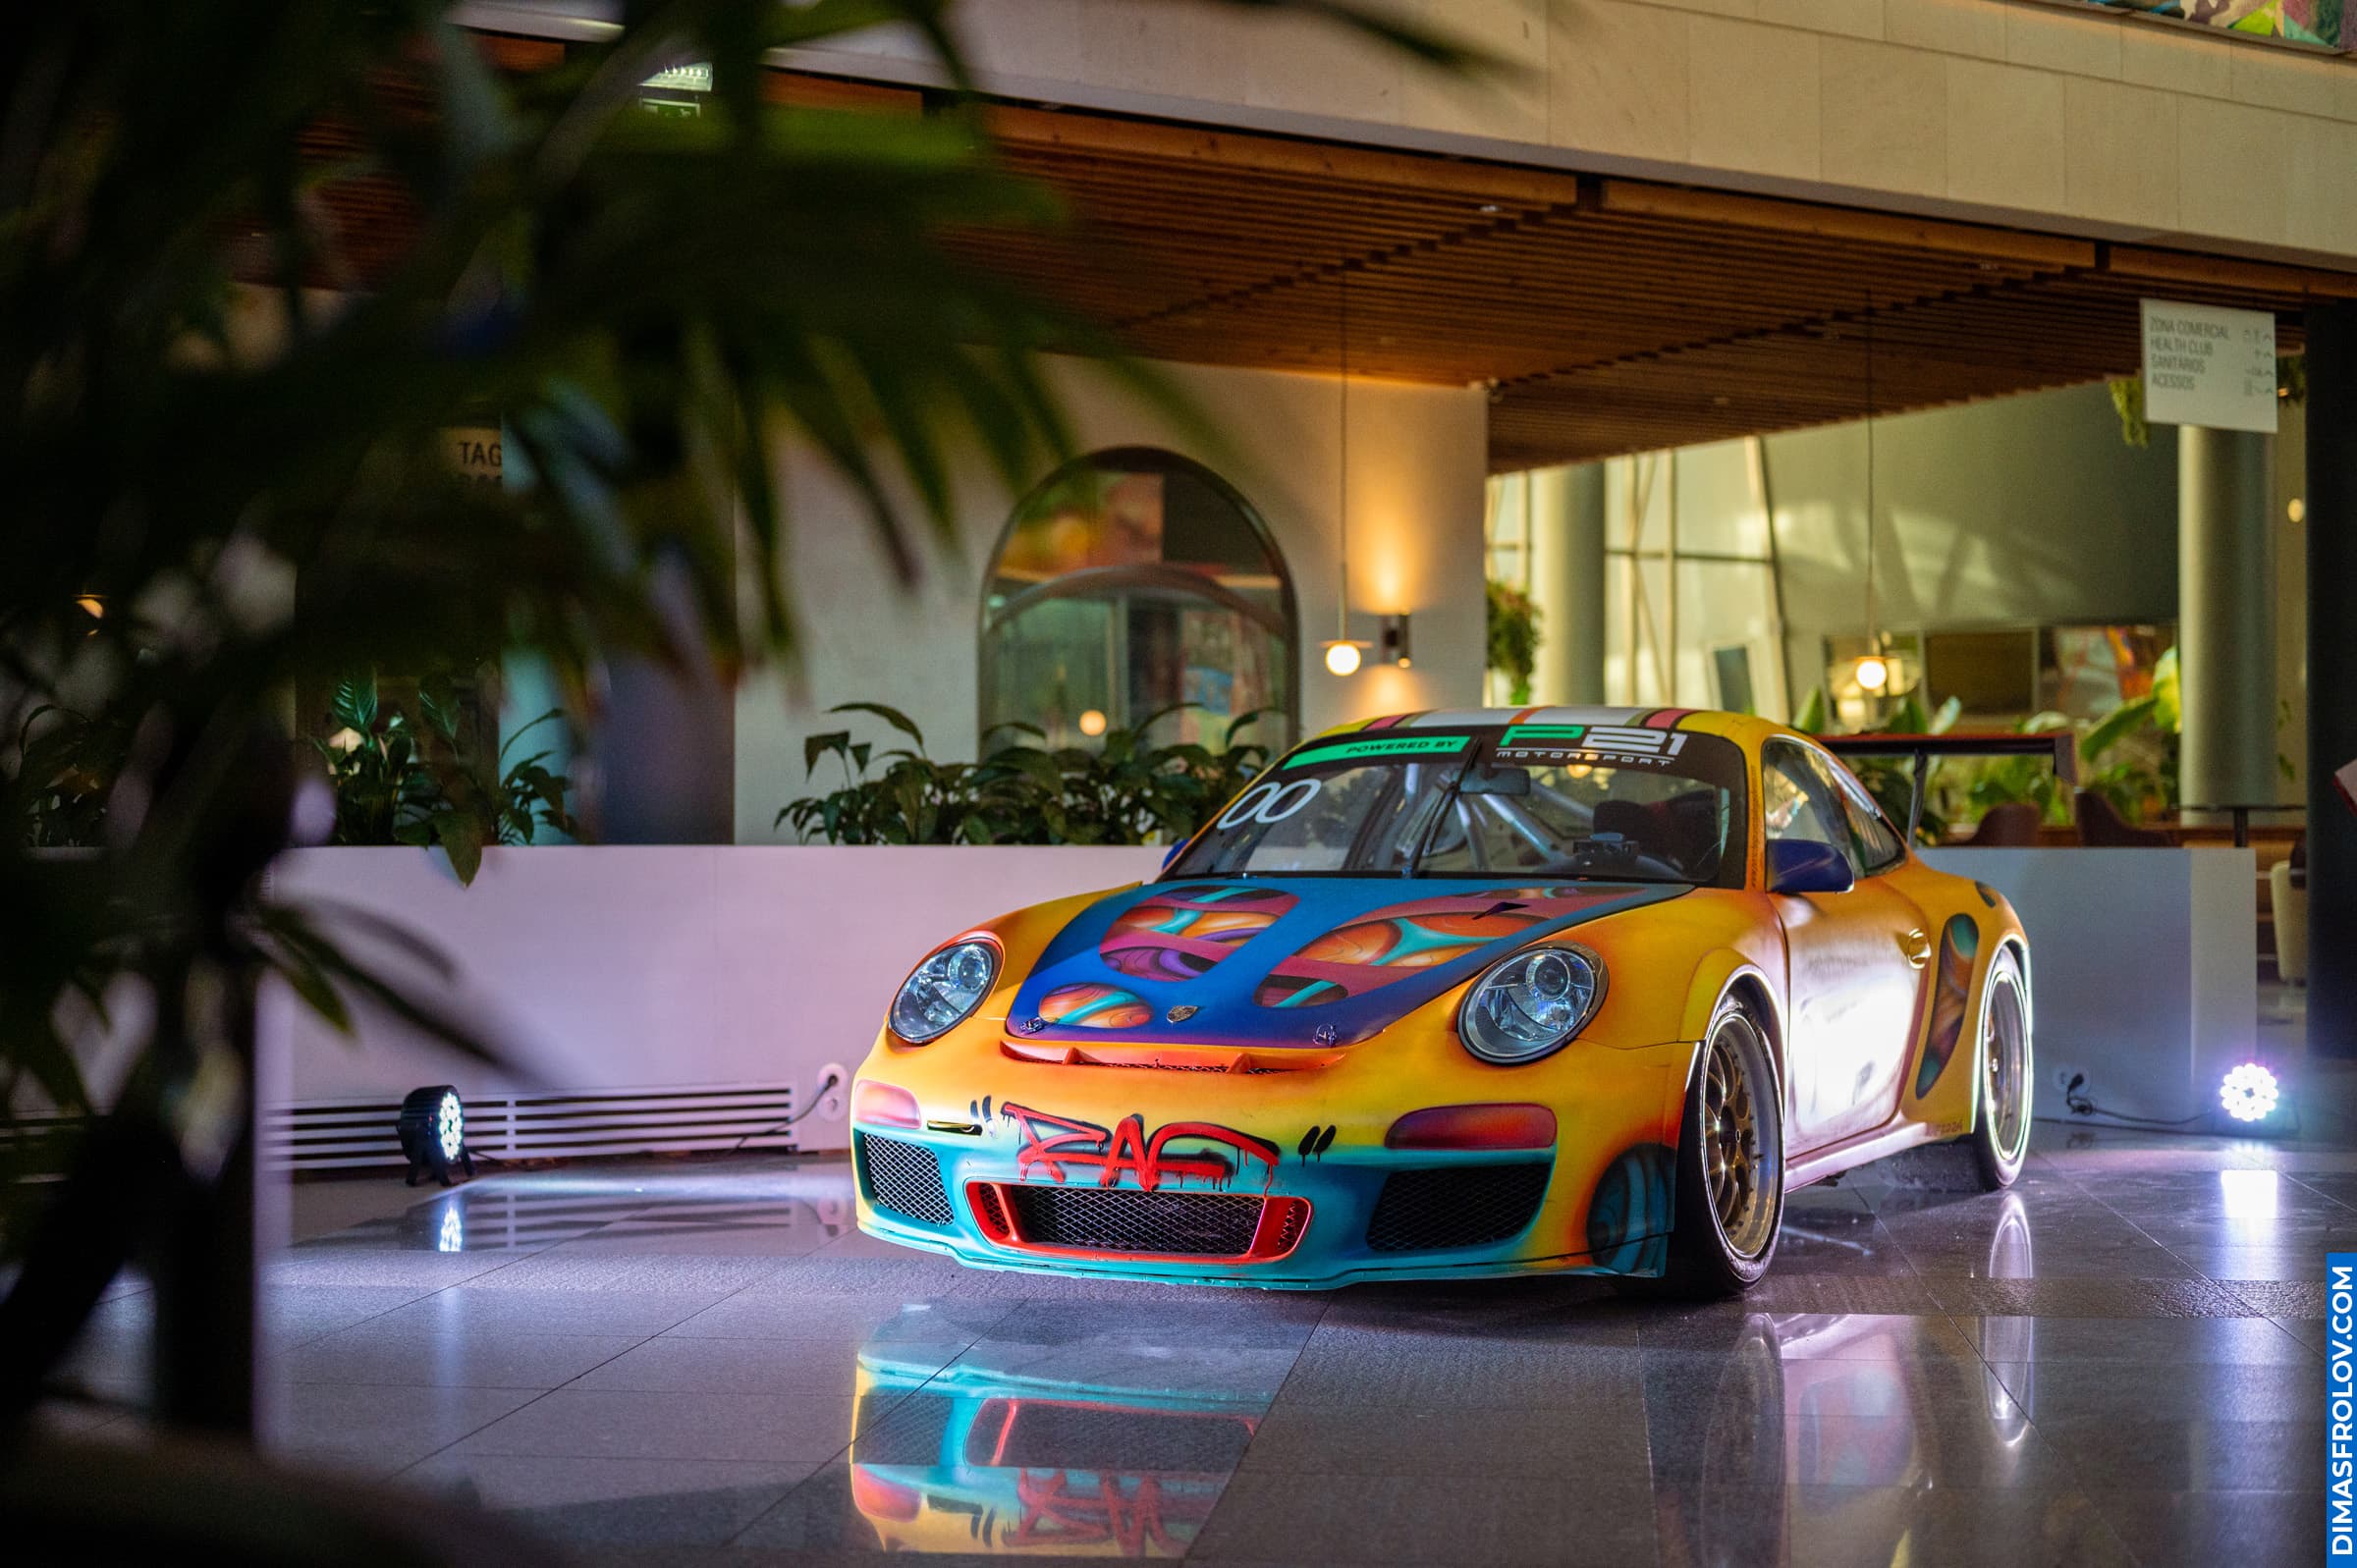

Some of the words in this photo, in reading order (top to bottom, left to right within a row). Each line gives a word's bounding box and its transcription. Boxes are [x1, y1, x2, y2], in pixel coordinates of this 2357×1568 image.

[2151, 315, 2174, 333] ZONA
[2176, 318, 2229, 340] COMERCIAL
[2151, 337, 2186, 353] HEALTH
[2188, 339, 2214, 356] CLUB
[1346, 740, 1431, 754] POWERED
[1499, 725, 1688, 756] P21
[1496, 750, 1671, 767] MOTORSPORT
